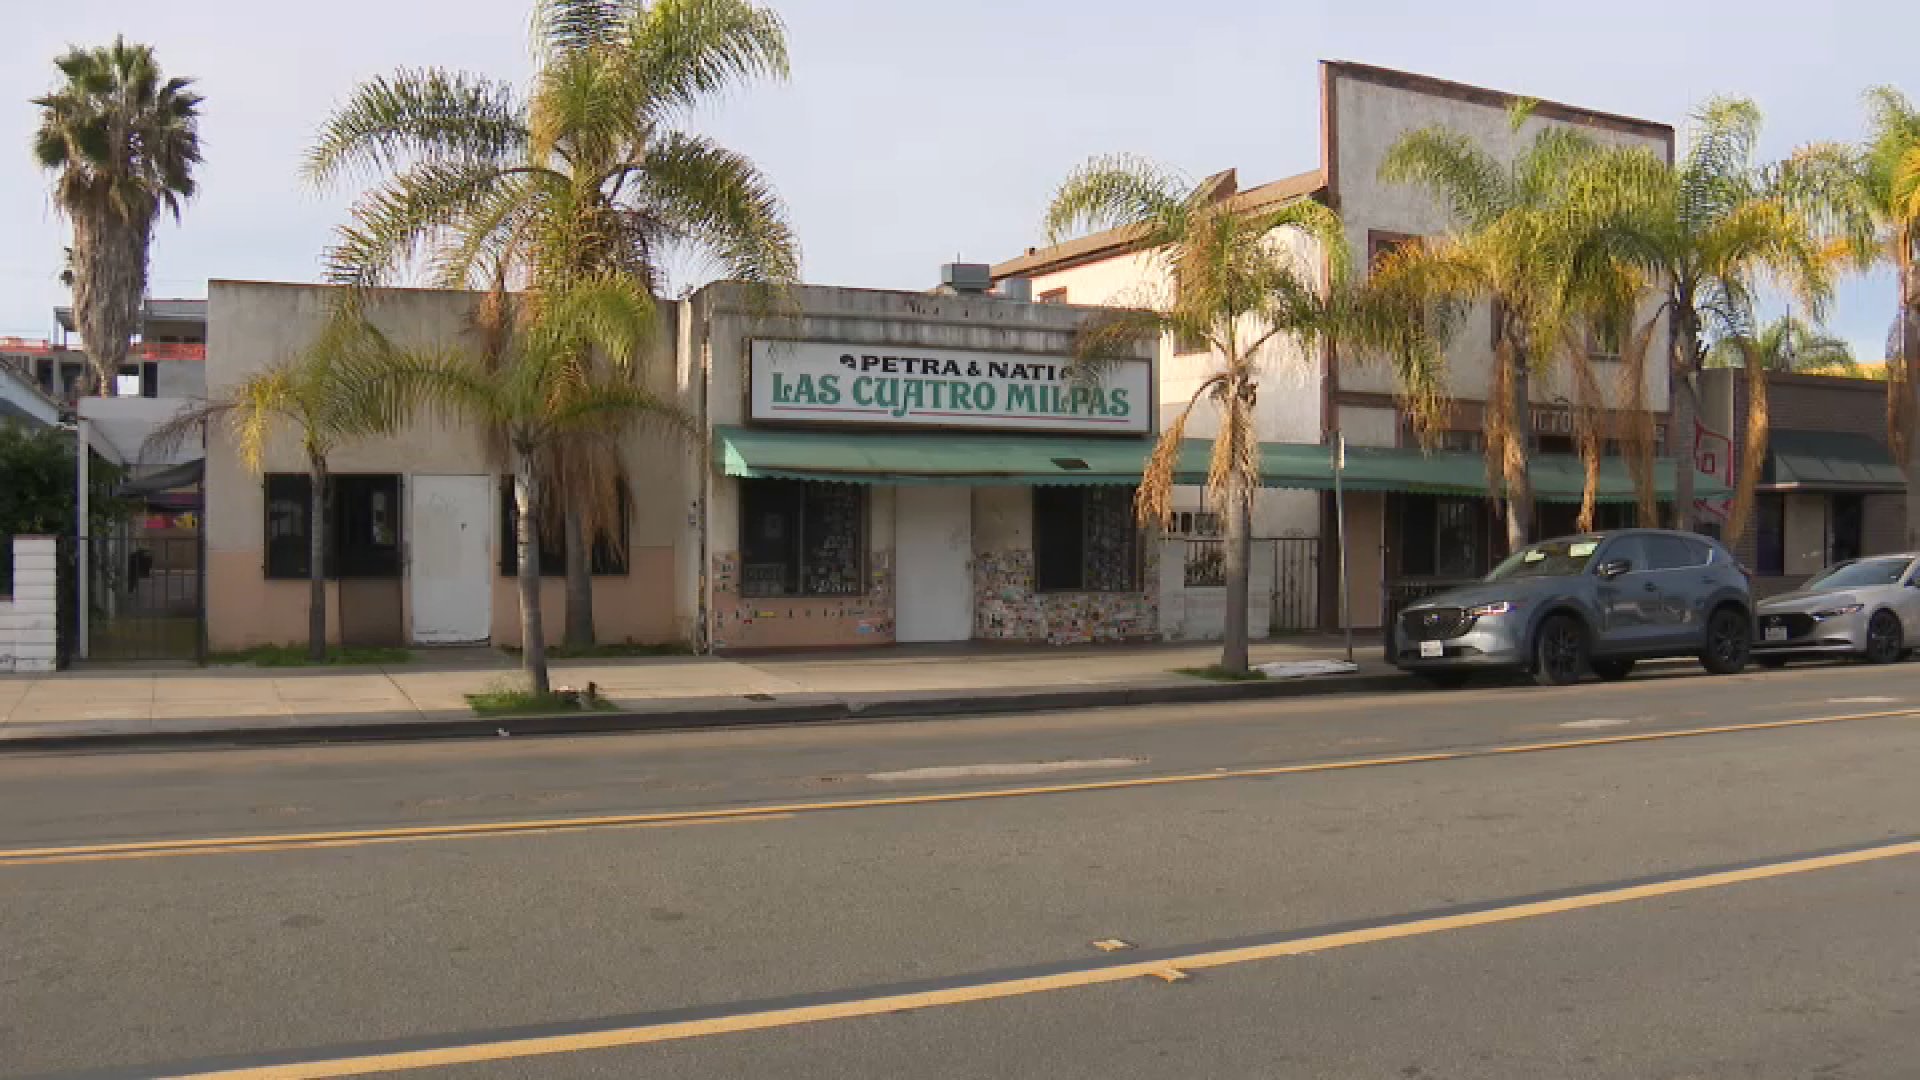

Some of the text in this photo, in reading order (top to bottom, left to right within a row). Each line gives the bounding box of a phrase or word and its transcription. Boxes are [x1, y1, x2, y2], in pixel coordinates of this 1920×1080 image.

[861, 354, 1056, 381] PETRA & NATI
[771, 372, 1130, 417] LAS CUATRO MILPAS
